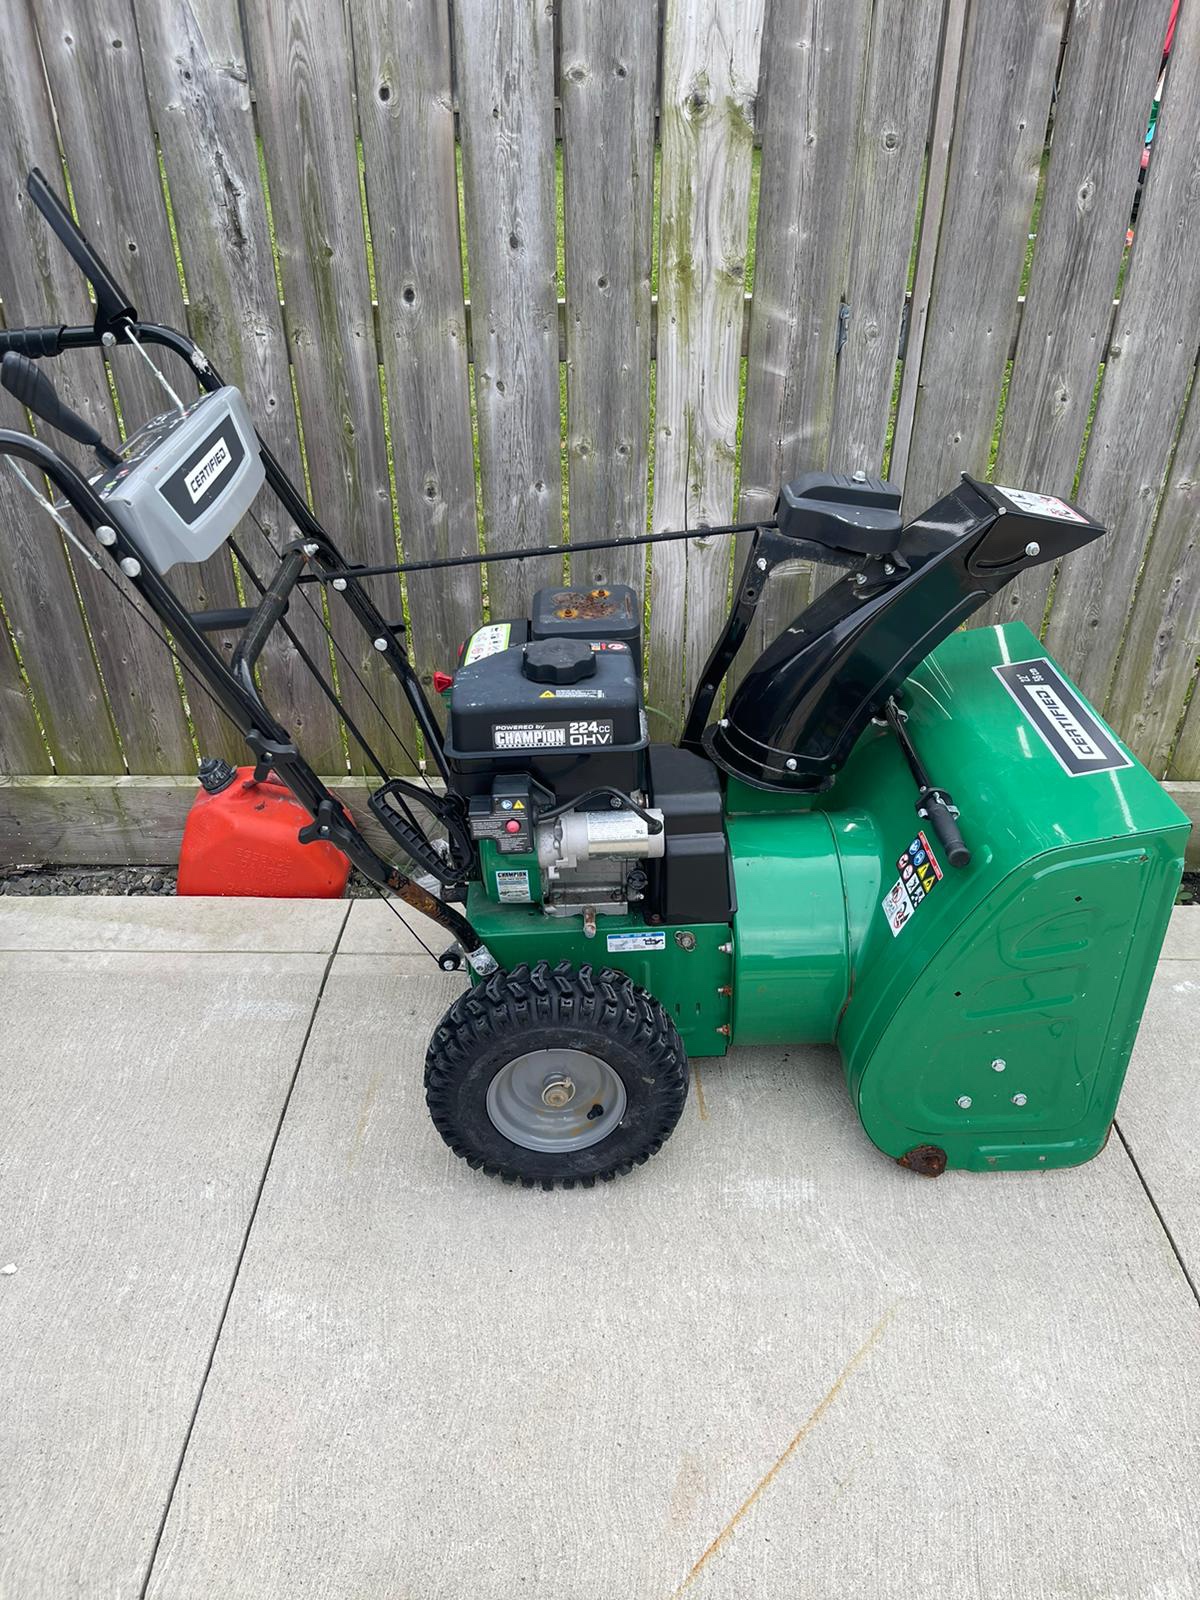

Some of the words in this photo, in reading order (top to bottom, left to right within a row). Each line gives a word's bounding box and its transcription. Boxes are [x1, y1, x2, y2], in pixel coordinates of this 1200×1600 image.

[190, 447, 227, 493] CERTIFIED
[495, 728, 566, 746] CHAMPION
[1035, 690, 1094, 755] CERTIFIED
[569, 733, 610, 746] OHV
